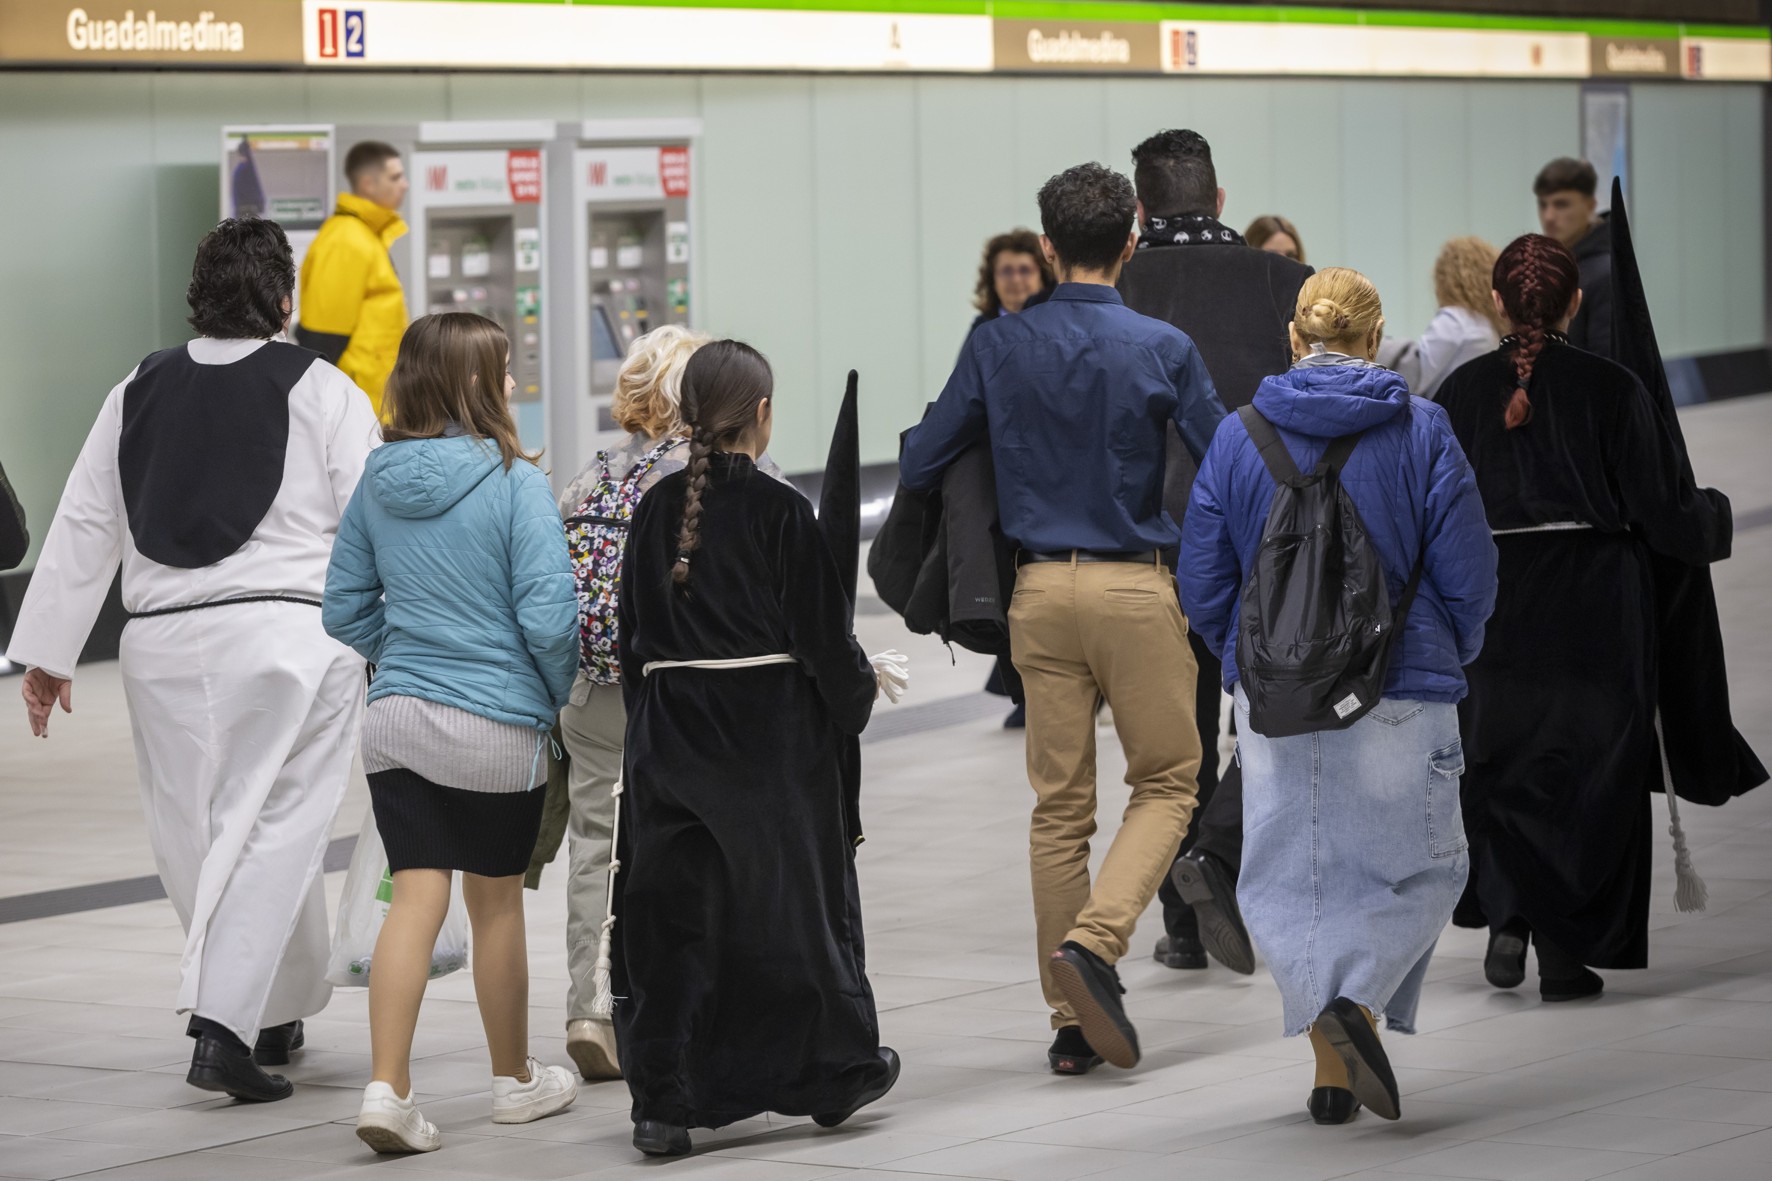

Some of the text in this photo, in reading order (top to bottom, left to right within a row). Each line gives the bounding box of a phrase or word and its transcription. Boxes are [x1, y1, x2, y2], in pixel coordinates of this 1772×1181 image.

[67, 8, 244, 52] Guadalmedina
[321, 11, 364, 56] 1 2
